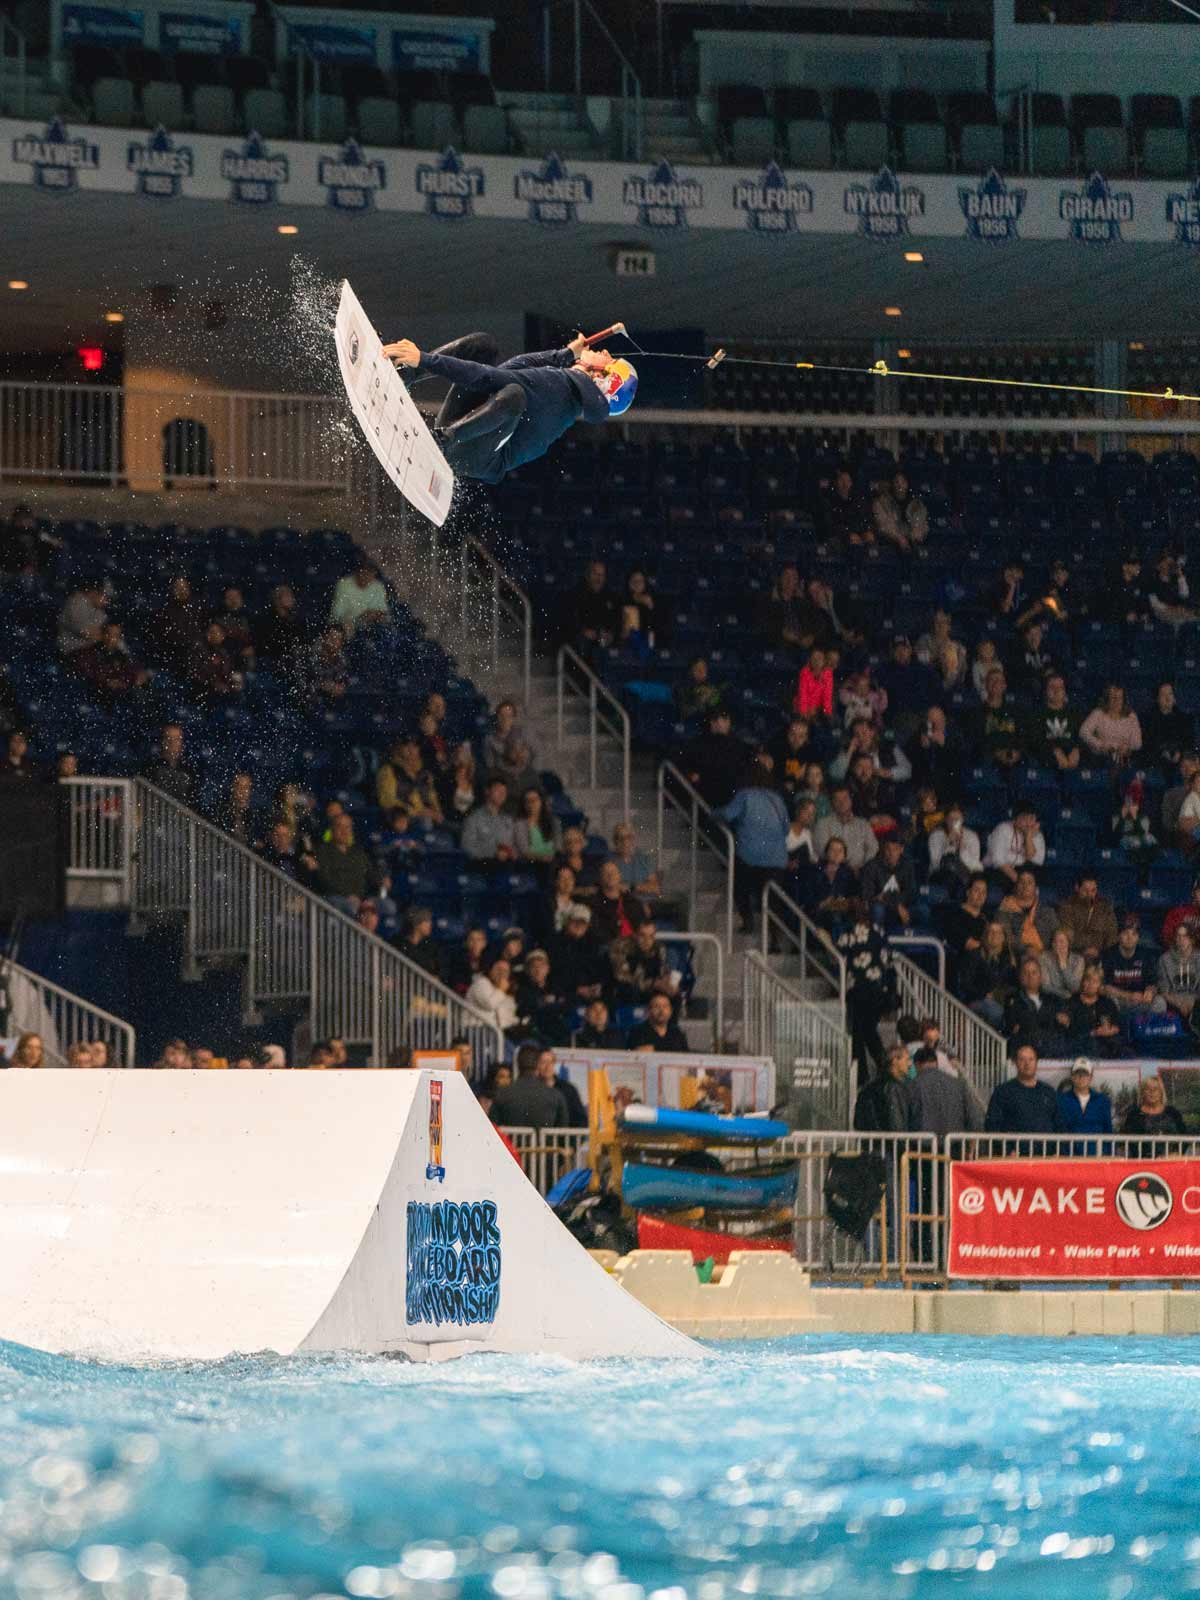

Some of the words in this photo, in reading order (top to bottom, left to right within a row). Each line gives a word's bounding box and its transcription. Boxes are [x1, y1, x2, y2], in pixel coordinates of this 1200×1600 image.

[132, 150, 190, 175] JAMES
[225, 157, 285, 181] HARRIS
[421, 171, 480, 197] HURST
[626, 183, 702, 207] ALDCORN
[737, 188, 810, 211] PULFORD
[847, 191, 923, 215] NYKOLUK
[968, 194, 1017, 217] BAUN
[1061, 197, 1132, 221] GIRARD
[623, 256, 648, 274] 114
[958, 1186, 1106, 1216] @WAKE
[958, 1243, 1040, 1258] Wakeboard
[1063, 1244, 1103, 1258] Wake
[1107, 1244, 1141, 1258] Park
[1163, 1244, 1200, 1258] Wake
